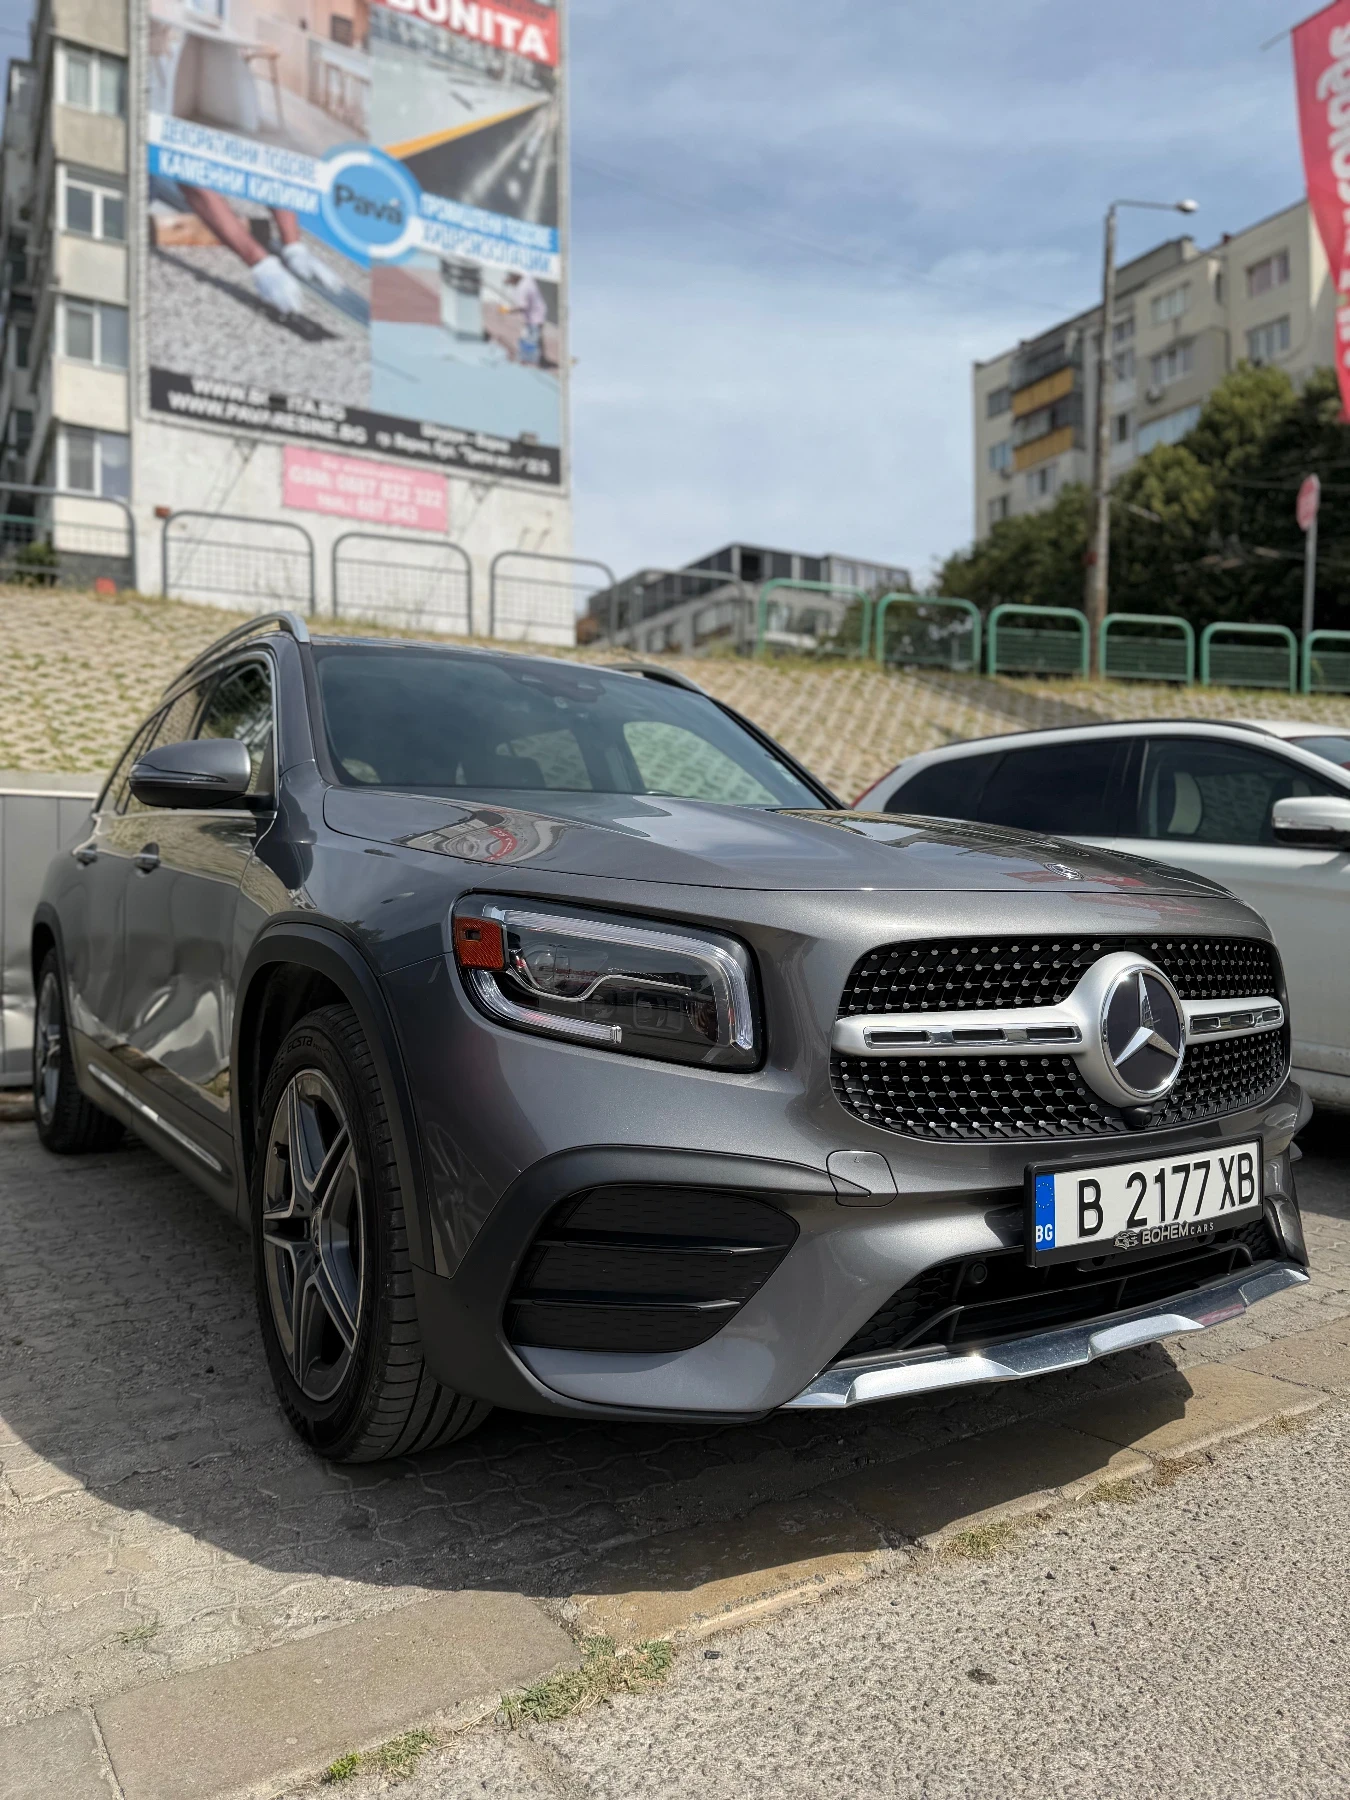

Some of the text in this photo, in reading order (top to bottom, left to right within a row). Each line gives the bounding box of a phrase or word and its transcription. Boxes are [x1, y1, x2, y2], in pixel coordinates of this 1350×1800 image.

[1036, 1151, 1256, 1243] BG B 2177 XB
[1141, 1221, 1215, 1245] BOHEM CARS
